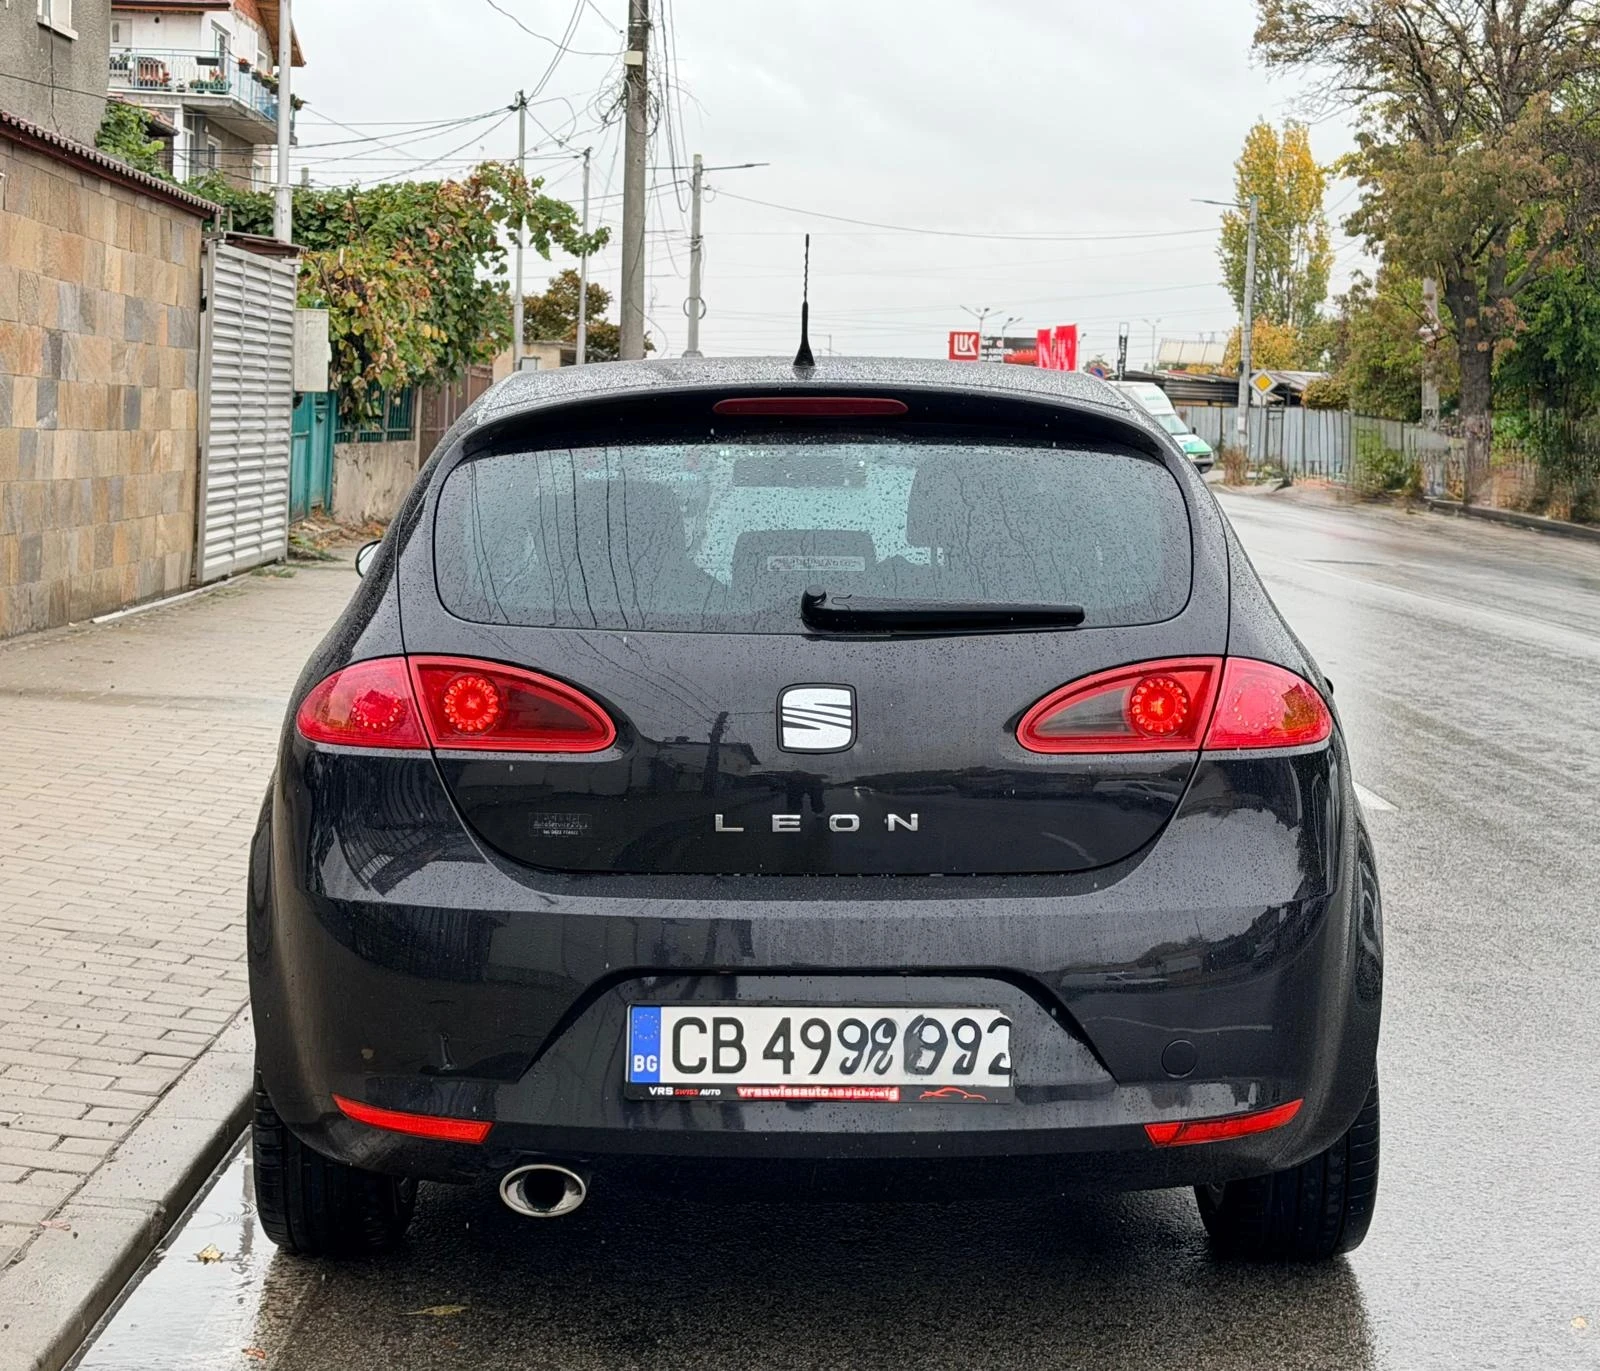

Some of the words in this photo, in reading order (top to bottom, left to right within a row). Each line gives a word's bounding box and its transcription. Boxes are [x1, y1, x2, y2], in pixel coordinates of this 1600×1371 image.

[714, 813, 919, 832] LEON
[633, 1054, 658, 1073] BG
[649, 1086, 674, 1096] VRS
[674, 1088, 699, 1096] SWISS
[699, 1088, 721, 1096] AUTO
